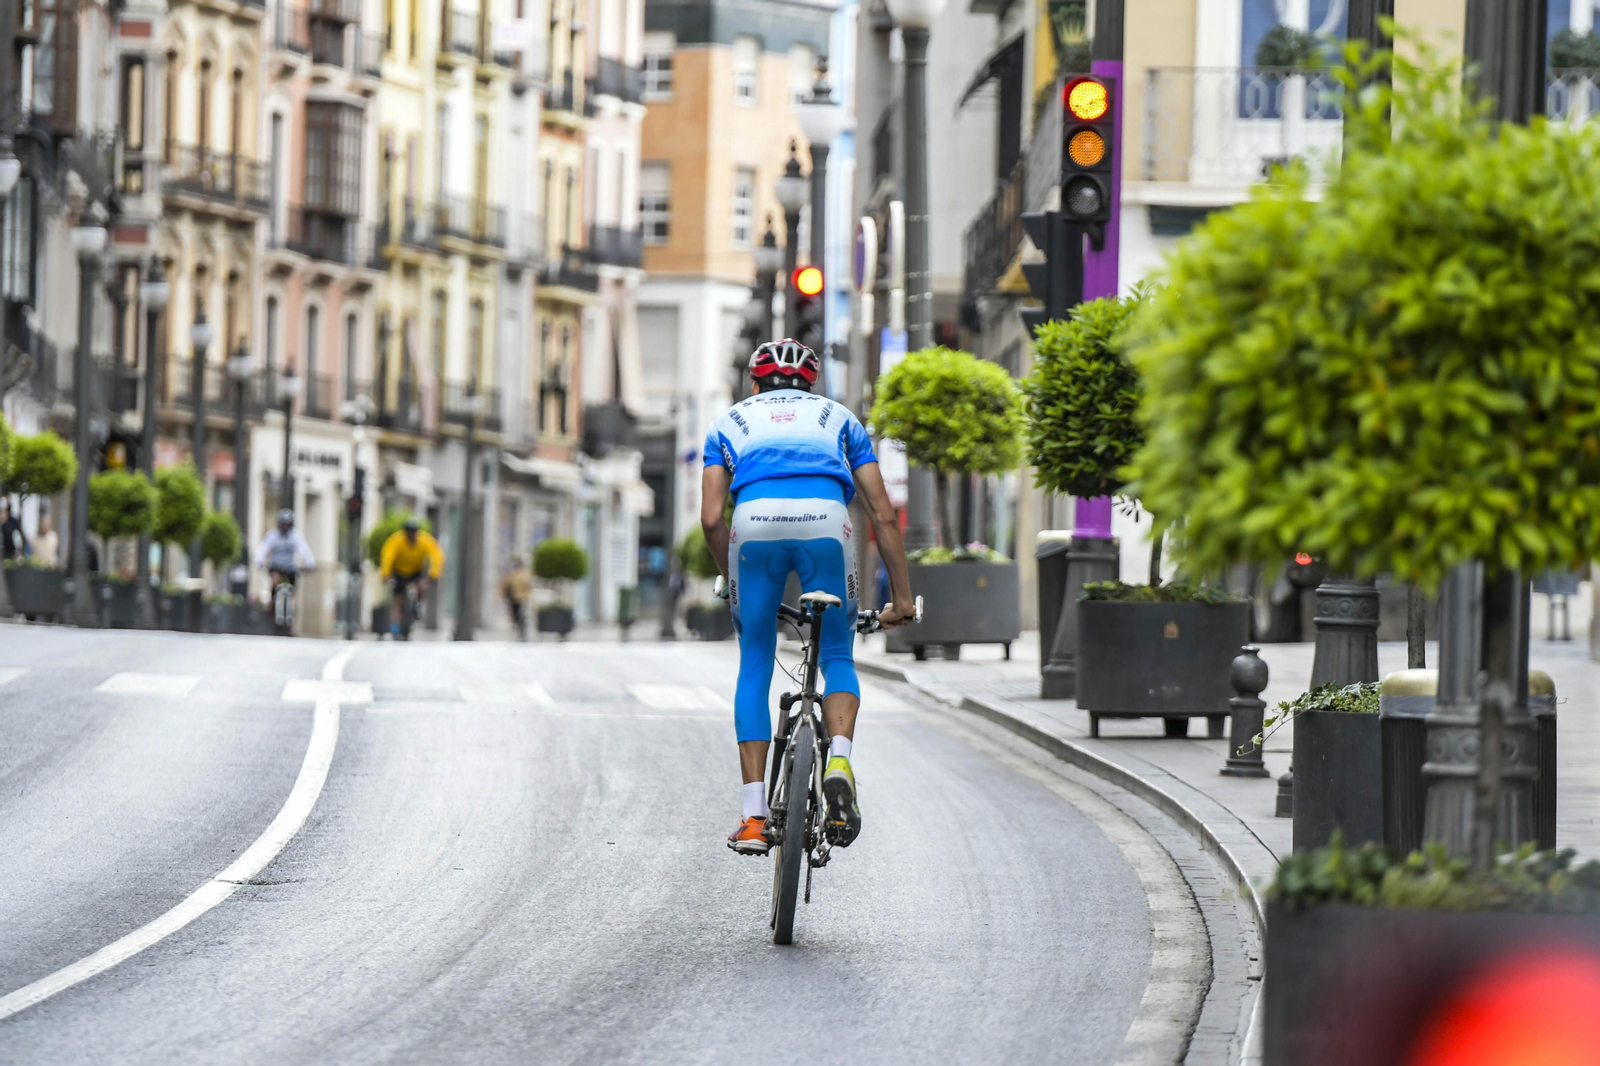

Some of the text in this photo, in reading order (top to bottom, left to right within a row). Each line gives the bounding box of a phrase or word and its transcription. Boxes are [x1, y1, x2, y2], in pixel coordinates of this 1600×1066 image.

[728, 409, 747, 428] SEMAR
[818, 406, 831, 429] SEMAR
[750, 513, 827, 522] www.semarelite.es
[730, 579, 738, 606] elite
[847, 573, 856, 600] elite
